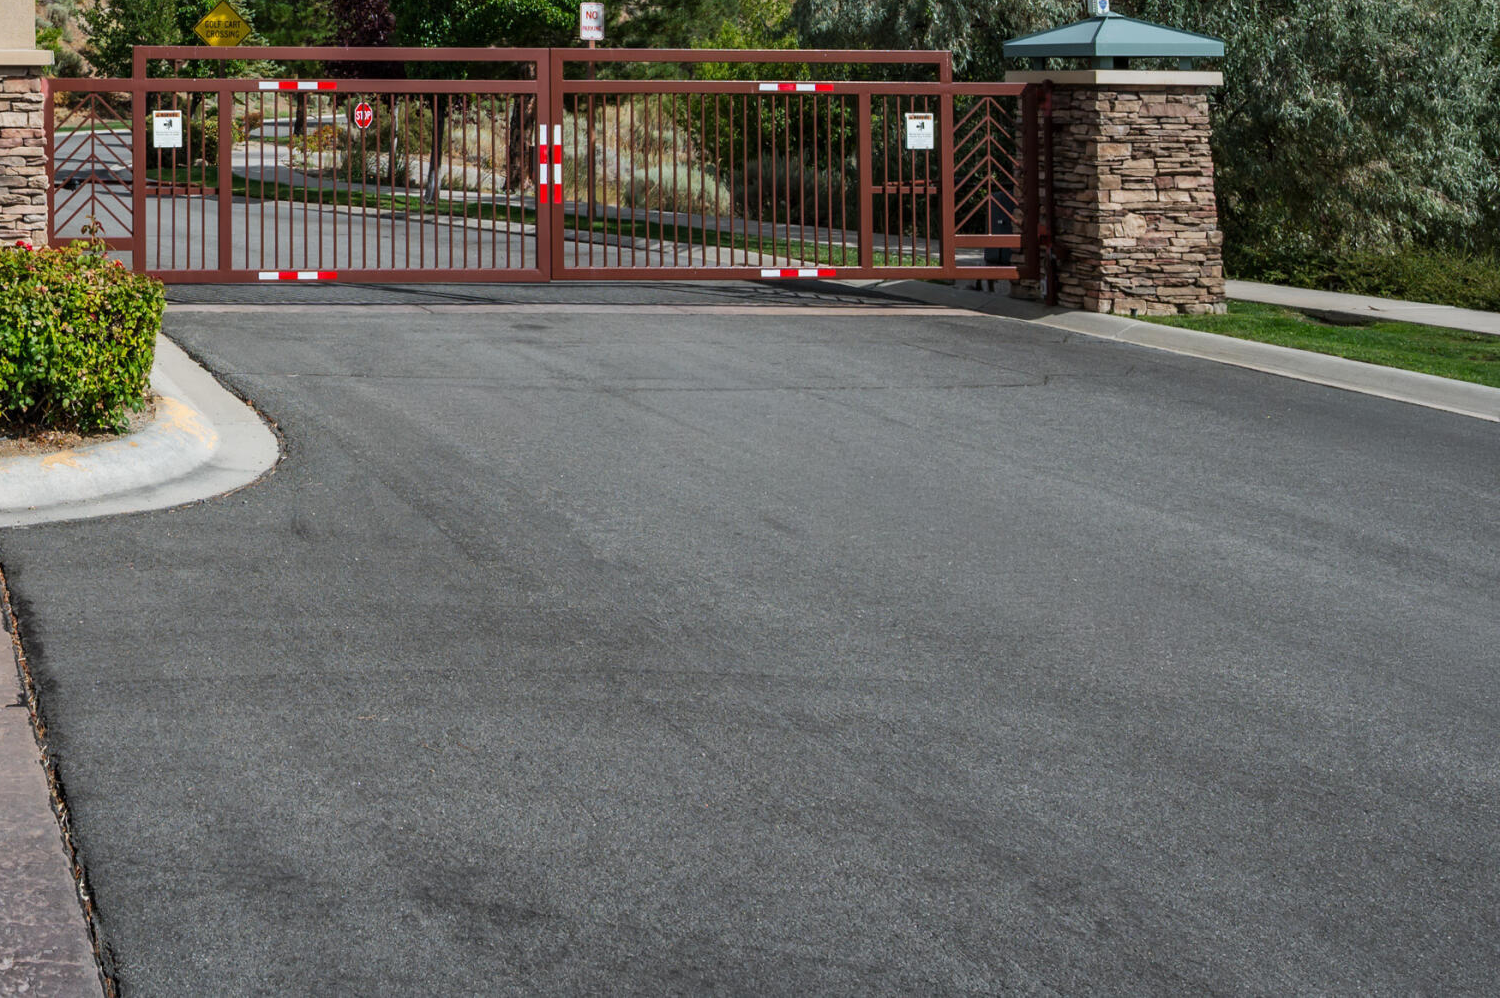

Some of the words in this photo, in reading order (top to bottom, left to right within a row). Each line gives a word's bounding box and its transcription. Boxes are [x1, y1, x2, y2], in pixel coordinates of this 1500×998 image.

[585, 10, 598, 20] NO
[204, 20, 221, 29] GOLF
[224, 20, 241, 29] CART
[205, 30, 240, 38] CROSSING
